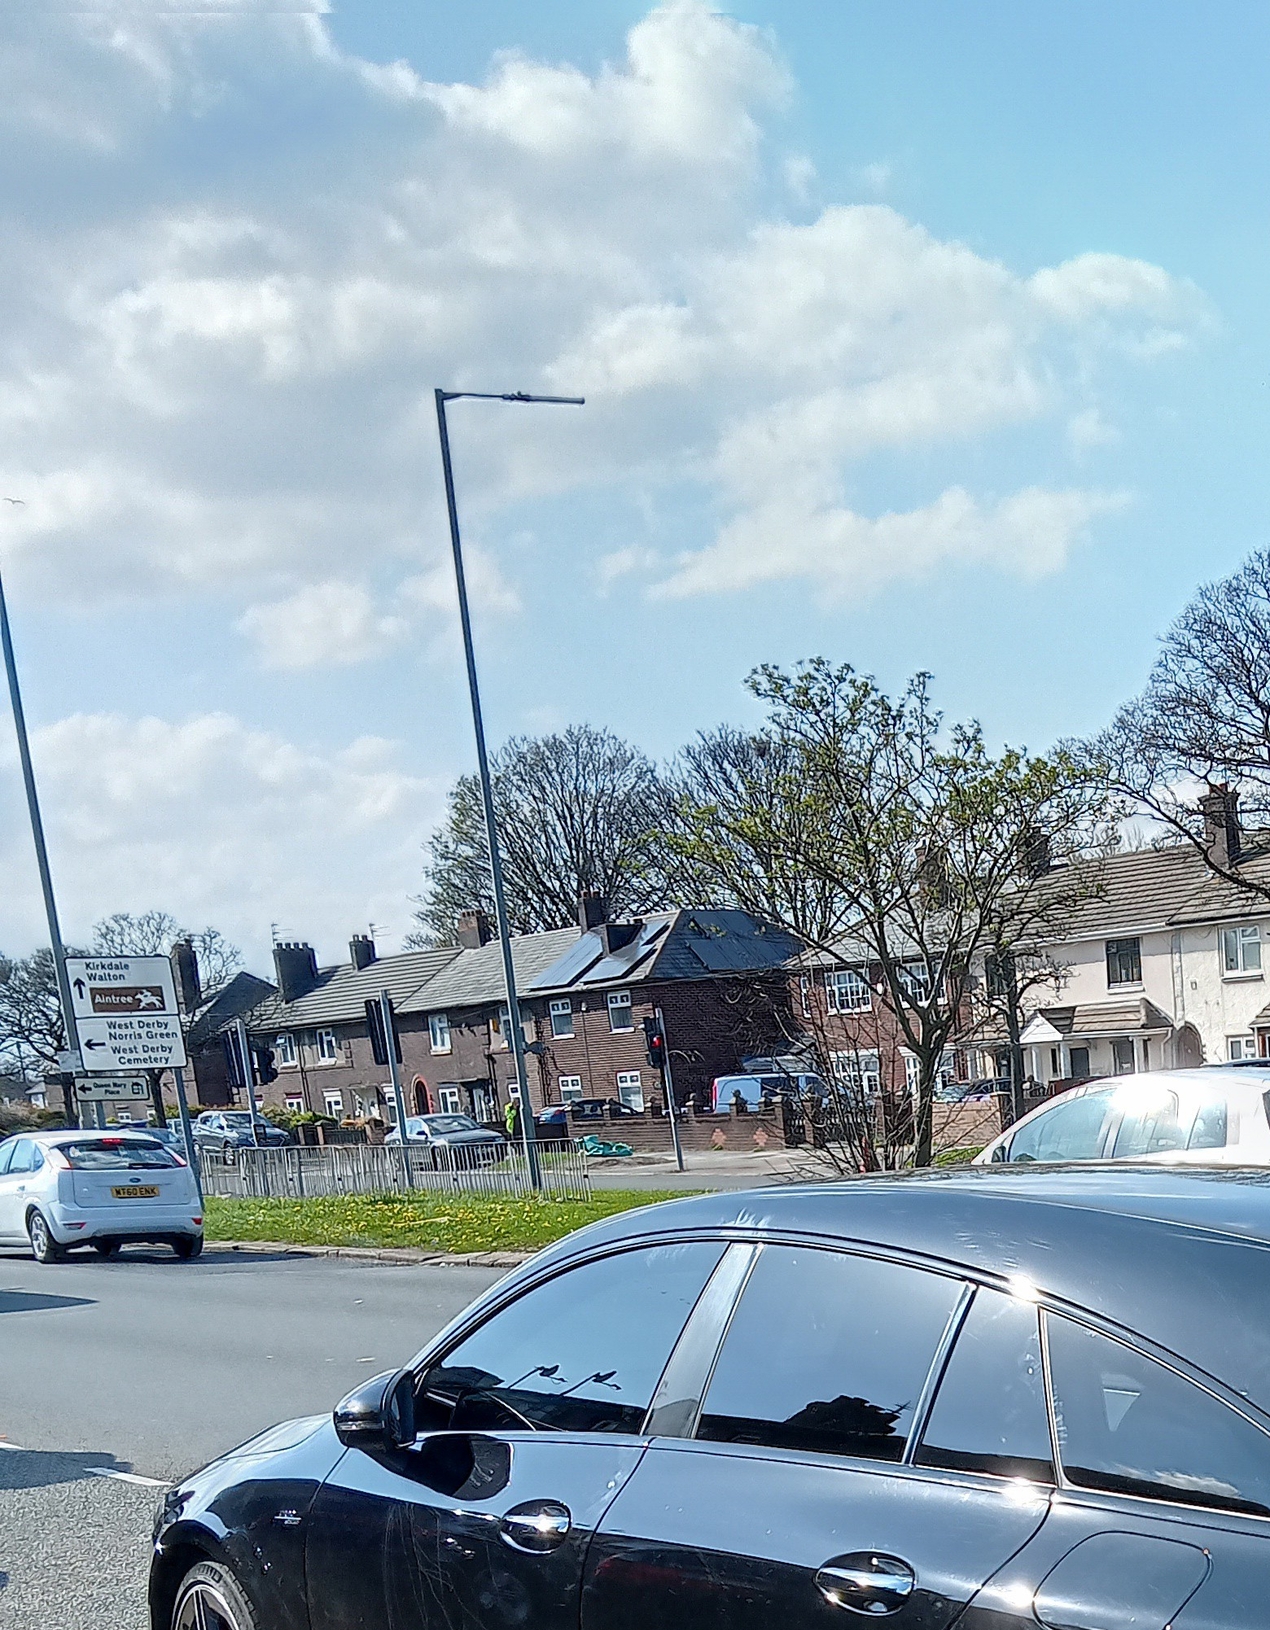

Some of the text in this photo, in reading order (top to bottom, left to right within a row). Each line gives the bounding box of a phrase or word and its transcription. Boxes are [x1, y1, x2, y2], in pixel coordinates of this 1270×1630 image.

[84, 961, 130, 971] Kirkdale
[86, 972, 126, 982] Walton
[94, 994, 133, 1004] Aintree
[106, 1020, 168, 1030] West Derby
[108, 1030, 178, 1040] Norris Green
[111, 1044, 173, 1054] West Derby
[118, 1055, 170, 1066] Cemetery
